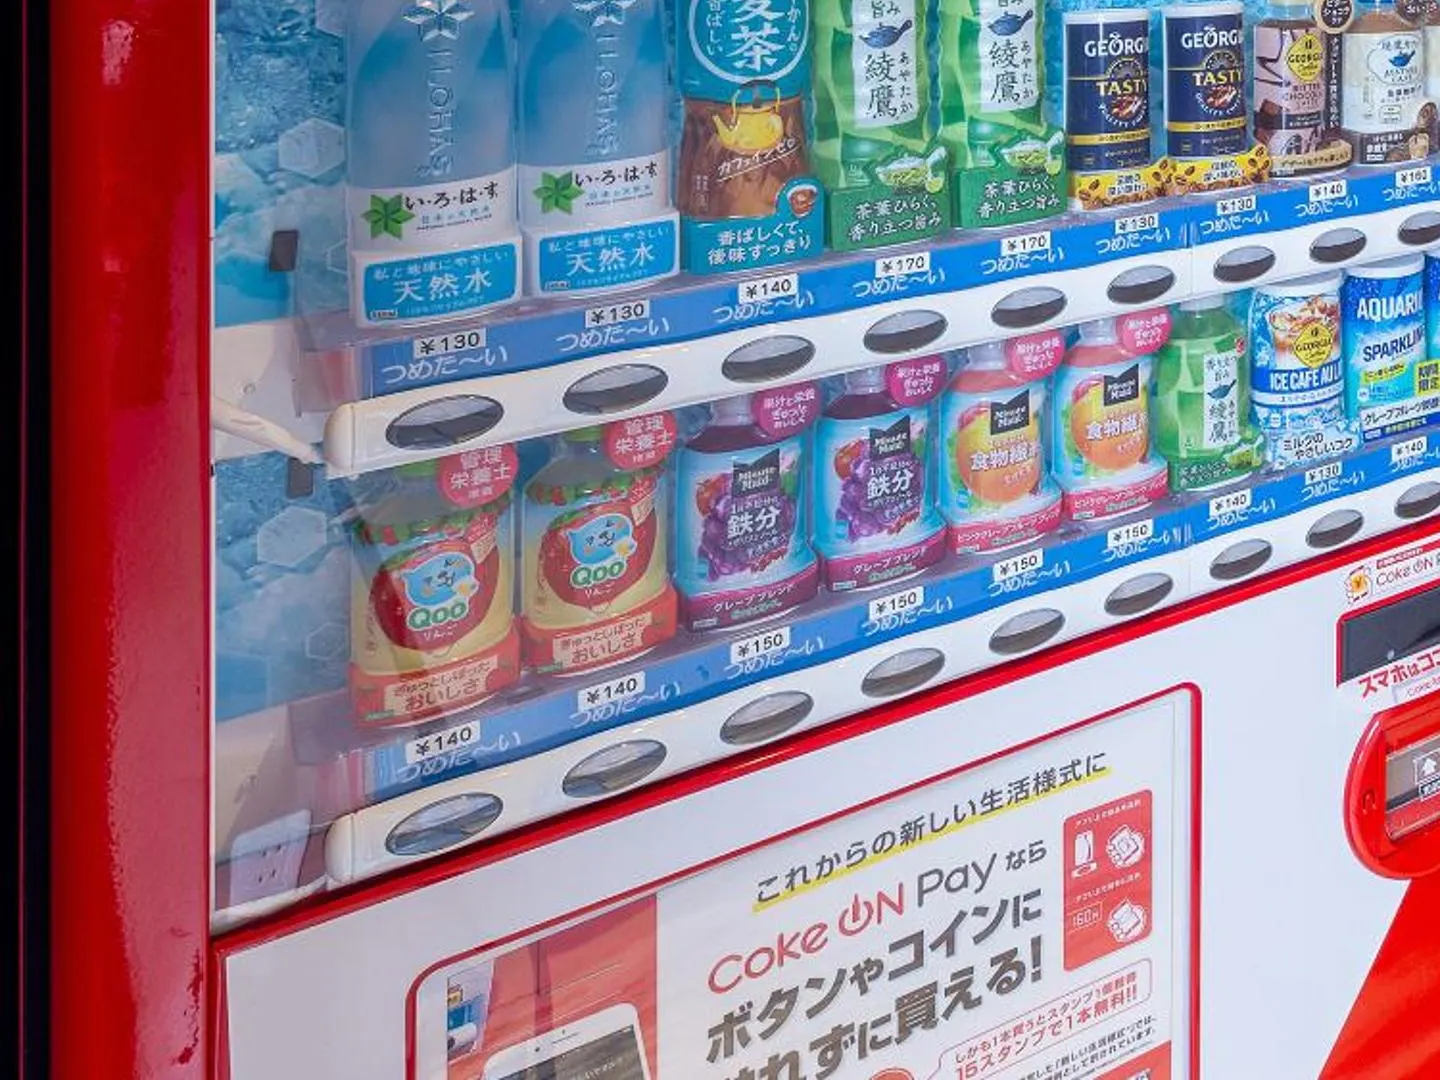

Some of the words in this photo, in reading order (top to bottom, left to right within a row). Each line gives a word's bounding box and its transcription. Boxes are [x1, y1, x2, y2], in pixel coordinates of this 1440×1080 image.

[987, 40, 1022, 104] 綾鷹
[863, 52, 898, 120] 綾鷹
[1312, 183, 1343, 199] ¥140
[1219, 198, 1254, 214] ¥130
[1117, 215, 1156, 233] ¥130
[1006, 234, 1048, 251] ¥170
[570, 242, 656, 277] 天然水
[879, 256, 926, 274] ¥170
[393, 267, 493, 305] 天然水
[744, 278, 792, 299] ¥140
[590, 303, 645, 324] ¥130
[420, 332, 480, 354] ¥130
[1270, 370, 1289, 392] ICE
[866, 472, 915, 501] 鉄分
[1214, 493, 1247, 511] ¥140
[726, 506, 781, 540] 鉄分
[1112, 524, 1149, 544] ¥150
[570, 561, 626, 589] Qoo
[998, 555, 1039, 577] ¥150
[1376, 565, 1411, 588] Coke
[407, 599, 469, 630] Qoo
[874, 591, 918, 616] ¥150
[571, 632, 643, 665] おいしさ
[736, 631, 785, 658] ¥150
[404, 677, 481, 712] おいしさ
[585, 677, 639, 704] ¥140
[415, 725, 472, 756] ¥140
[756, 751, 1109, 905] これからの新しい生活様式に
[707, 921, 829, 995] Coke
[837, 880, 906, 938] ON
[916, 851, 998, 909] Pay
[1004, 839, 1049, 872] なら
[705, 888, 1043, 1065] ボタンやコインに
[722, 935, 1044, 1080] れずに買える!
